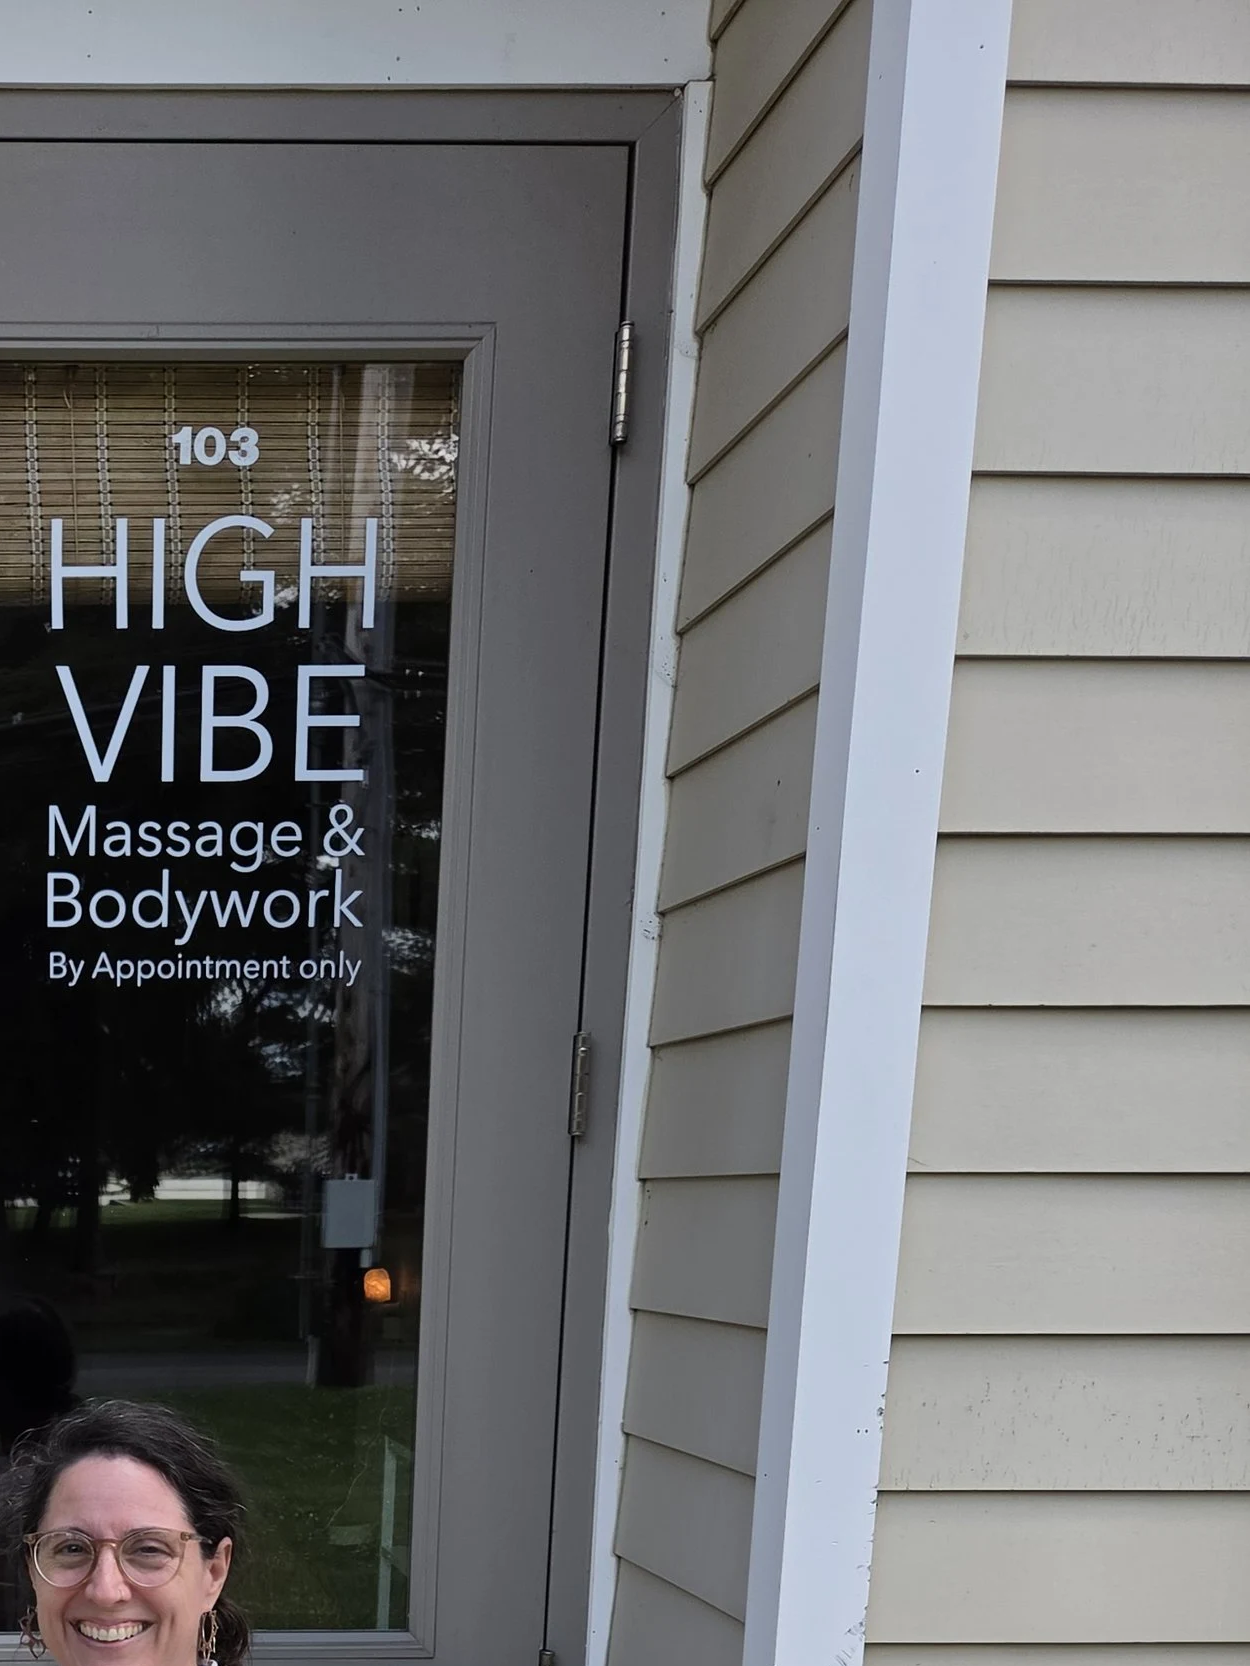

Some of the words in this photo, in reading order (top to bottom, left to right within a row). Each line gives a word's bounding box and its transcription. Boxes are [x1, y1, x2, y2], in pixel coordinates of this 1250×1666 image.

[172, 427, 260, 467] 103
[49, 514, 379, 632] HIGH
[55, 664, 368, 784] VIBE
[47, 805, 303, 874] Massage
[322, 803, 366, 857] &
[45, 869, 364, 946] Bodywork
[47, 952, 85, 986] By
[91, 952, 291, 986] Appointment
[298, 952, 362, 986] only
